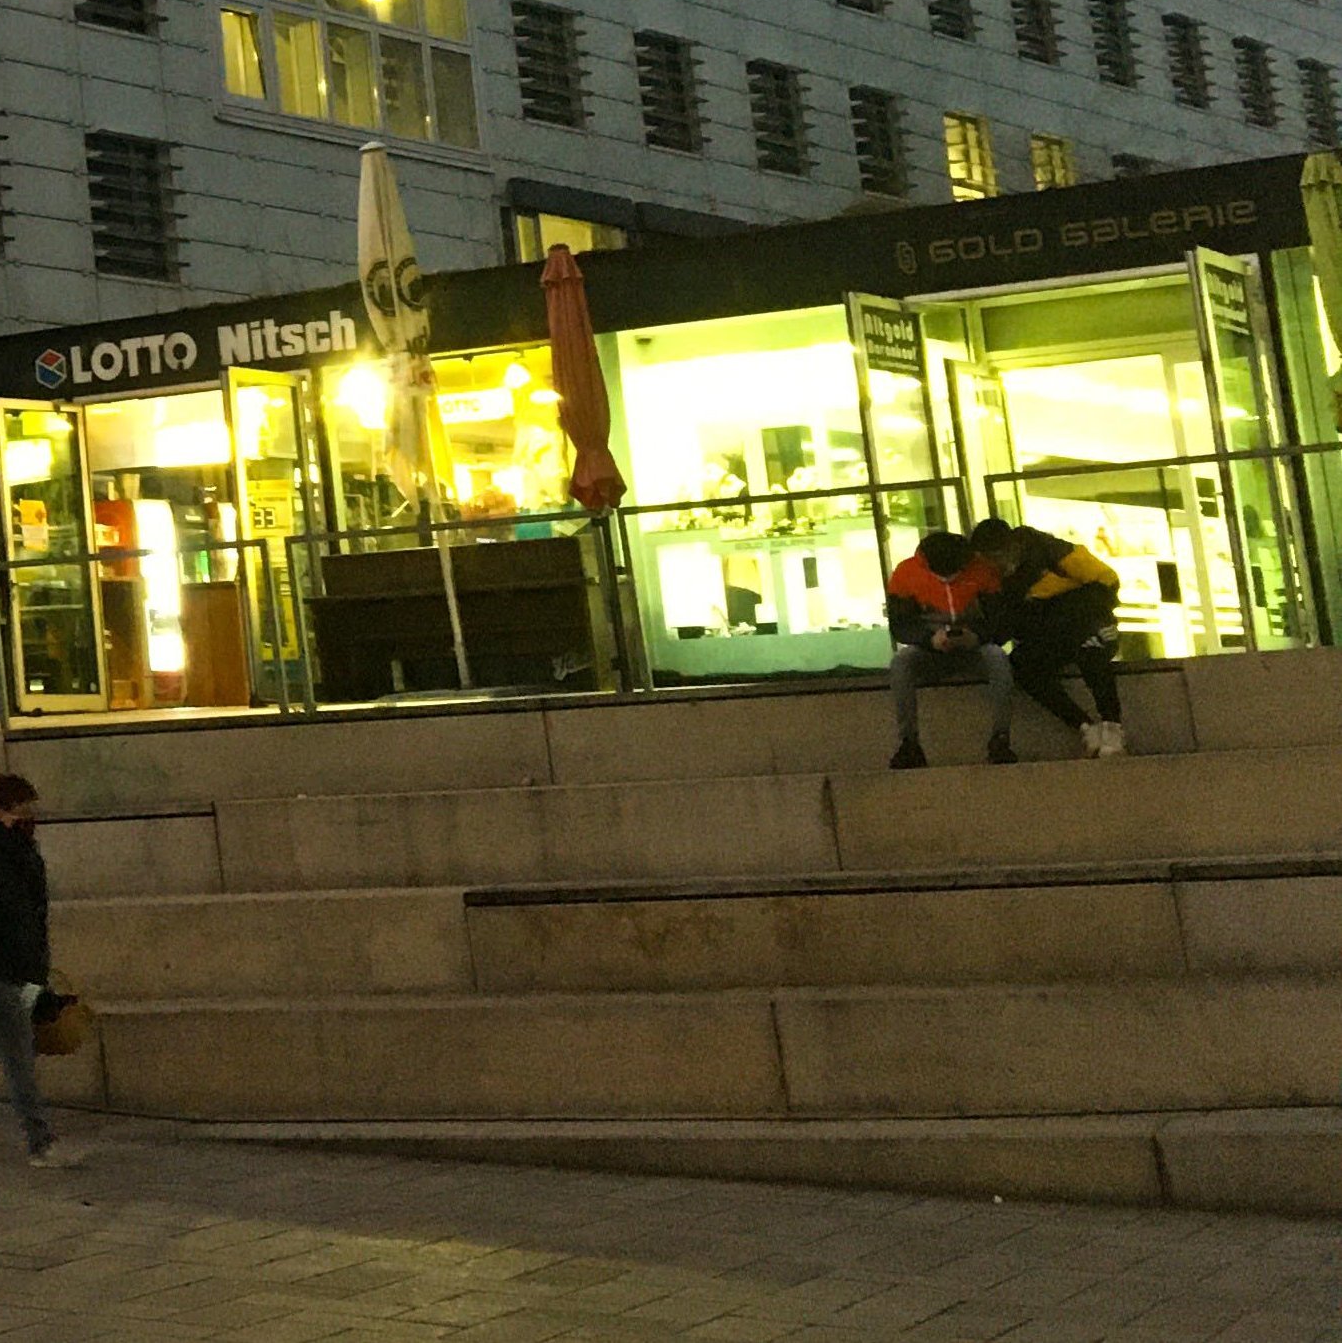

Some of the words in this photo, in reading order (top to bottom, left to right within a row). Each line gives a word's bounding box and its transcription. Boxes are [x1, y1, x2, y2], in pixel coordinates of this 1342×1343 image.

[928, 227, 1044, 263] GOLD
[70, 331, 198, 384] LOTTO
[217, 310, 357, 366] Nitsch
